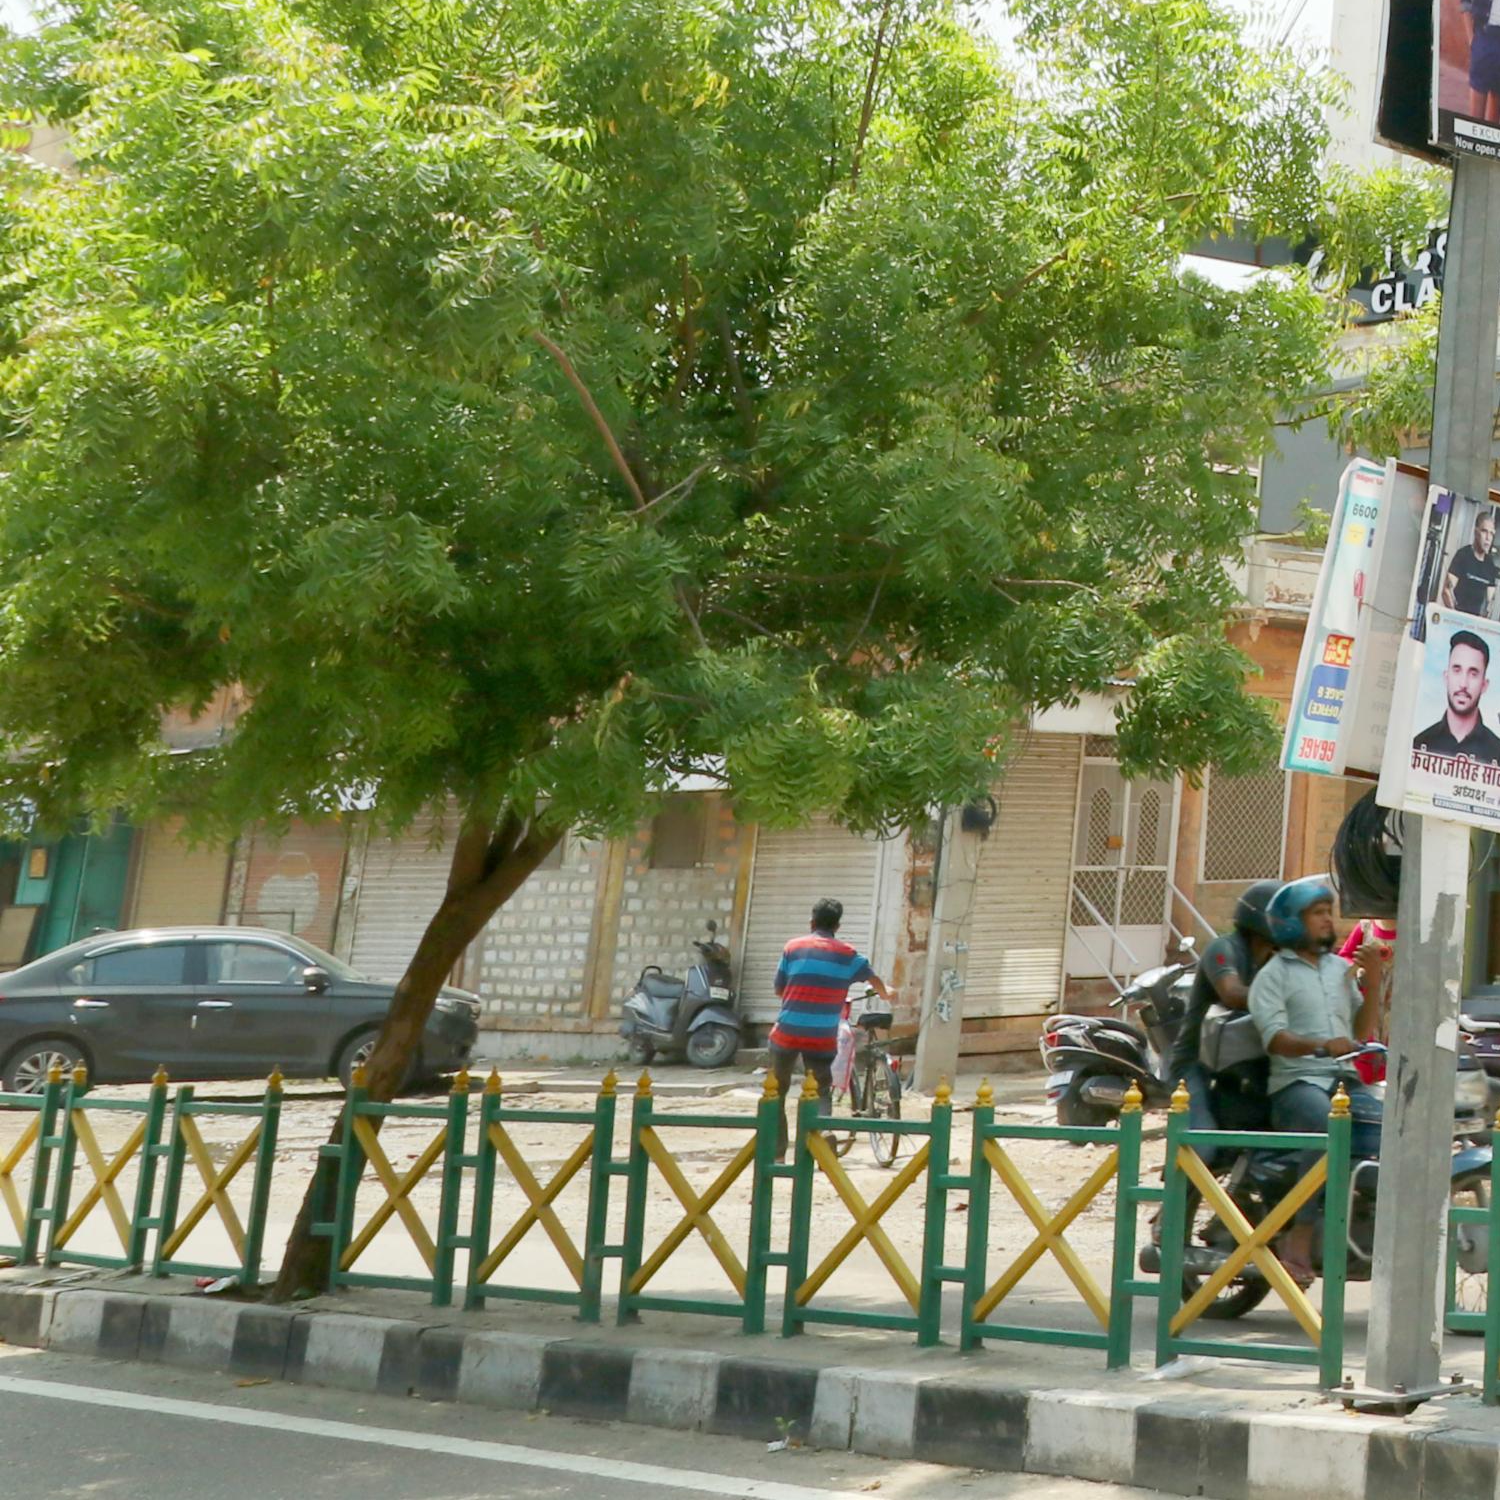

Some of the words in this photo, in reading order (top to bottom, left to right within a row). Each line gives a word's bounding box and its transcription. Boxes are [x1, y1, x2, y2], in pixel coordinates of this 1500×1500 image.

[1454, 134, 1475, 150] Now
[1475, 143, 1496, 157] open
[1452, 785, 1487, 803] अध्यक्ष
